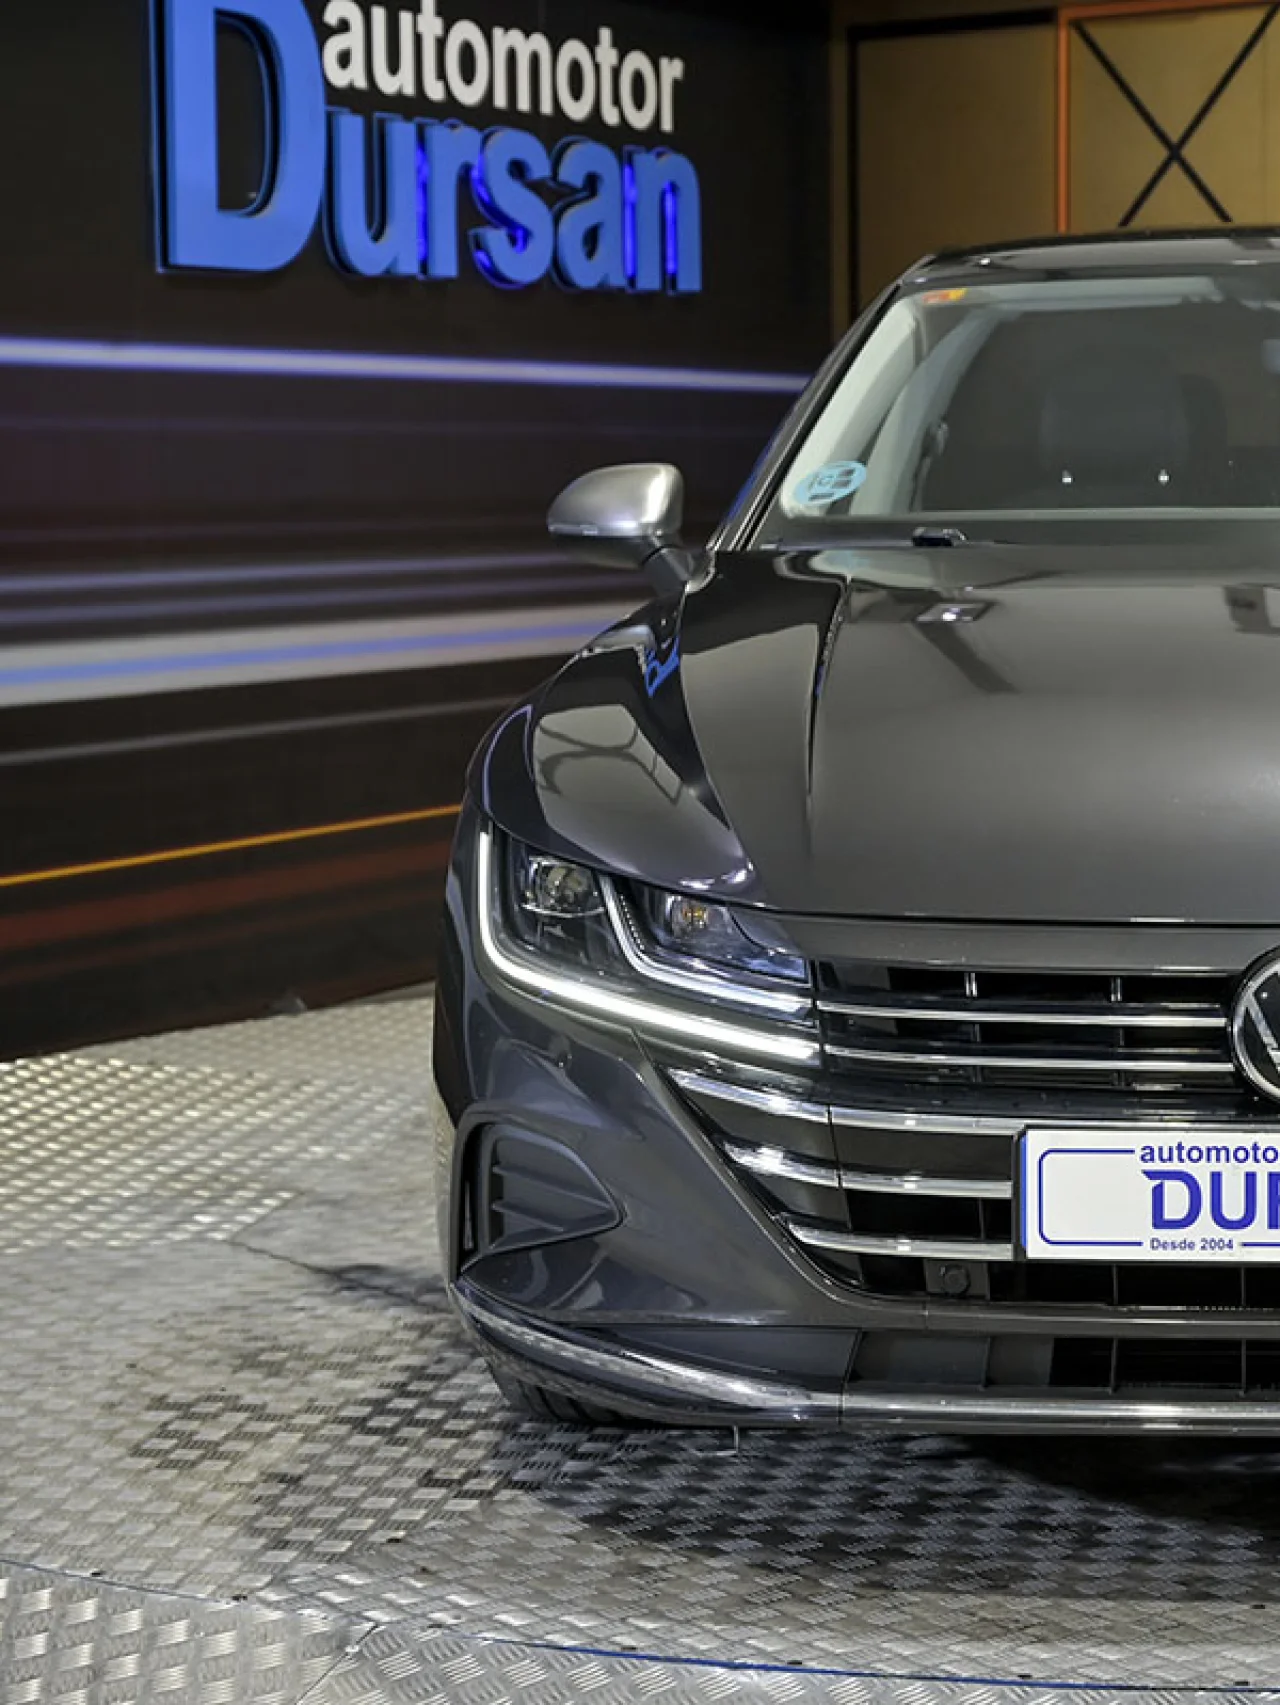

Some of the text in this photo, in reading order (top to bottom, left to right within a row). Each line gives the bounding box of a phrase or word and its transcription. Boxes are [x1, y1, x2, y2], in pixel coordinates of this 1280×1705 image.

[322, 0, 684, 133] automotor
[153, 0, 702, 294] Dursan
[1149, 1237, 1235, 1252] Desde 2004
